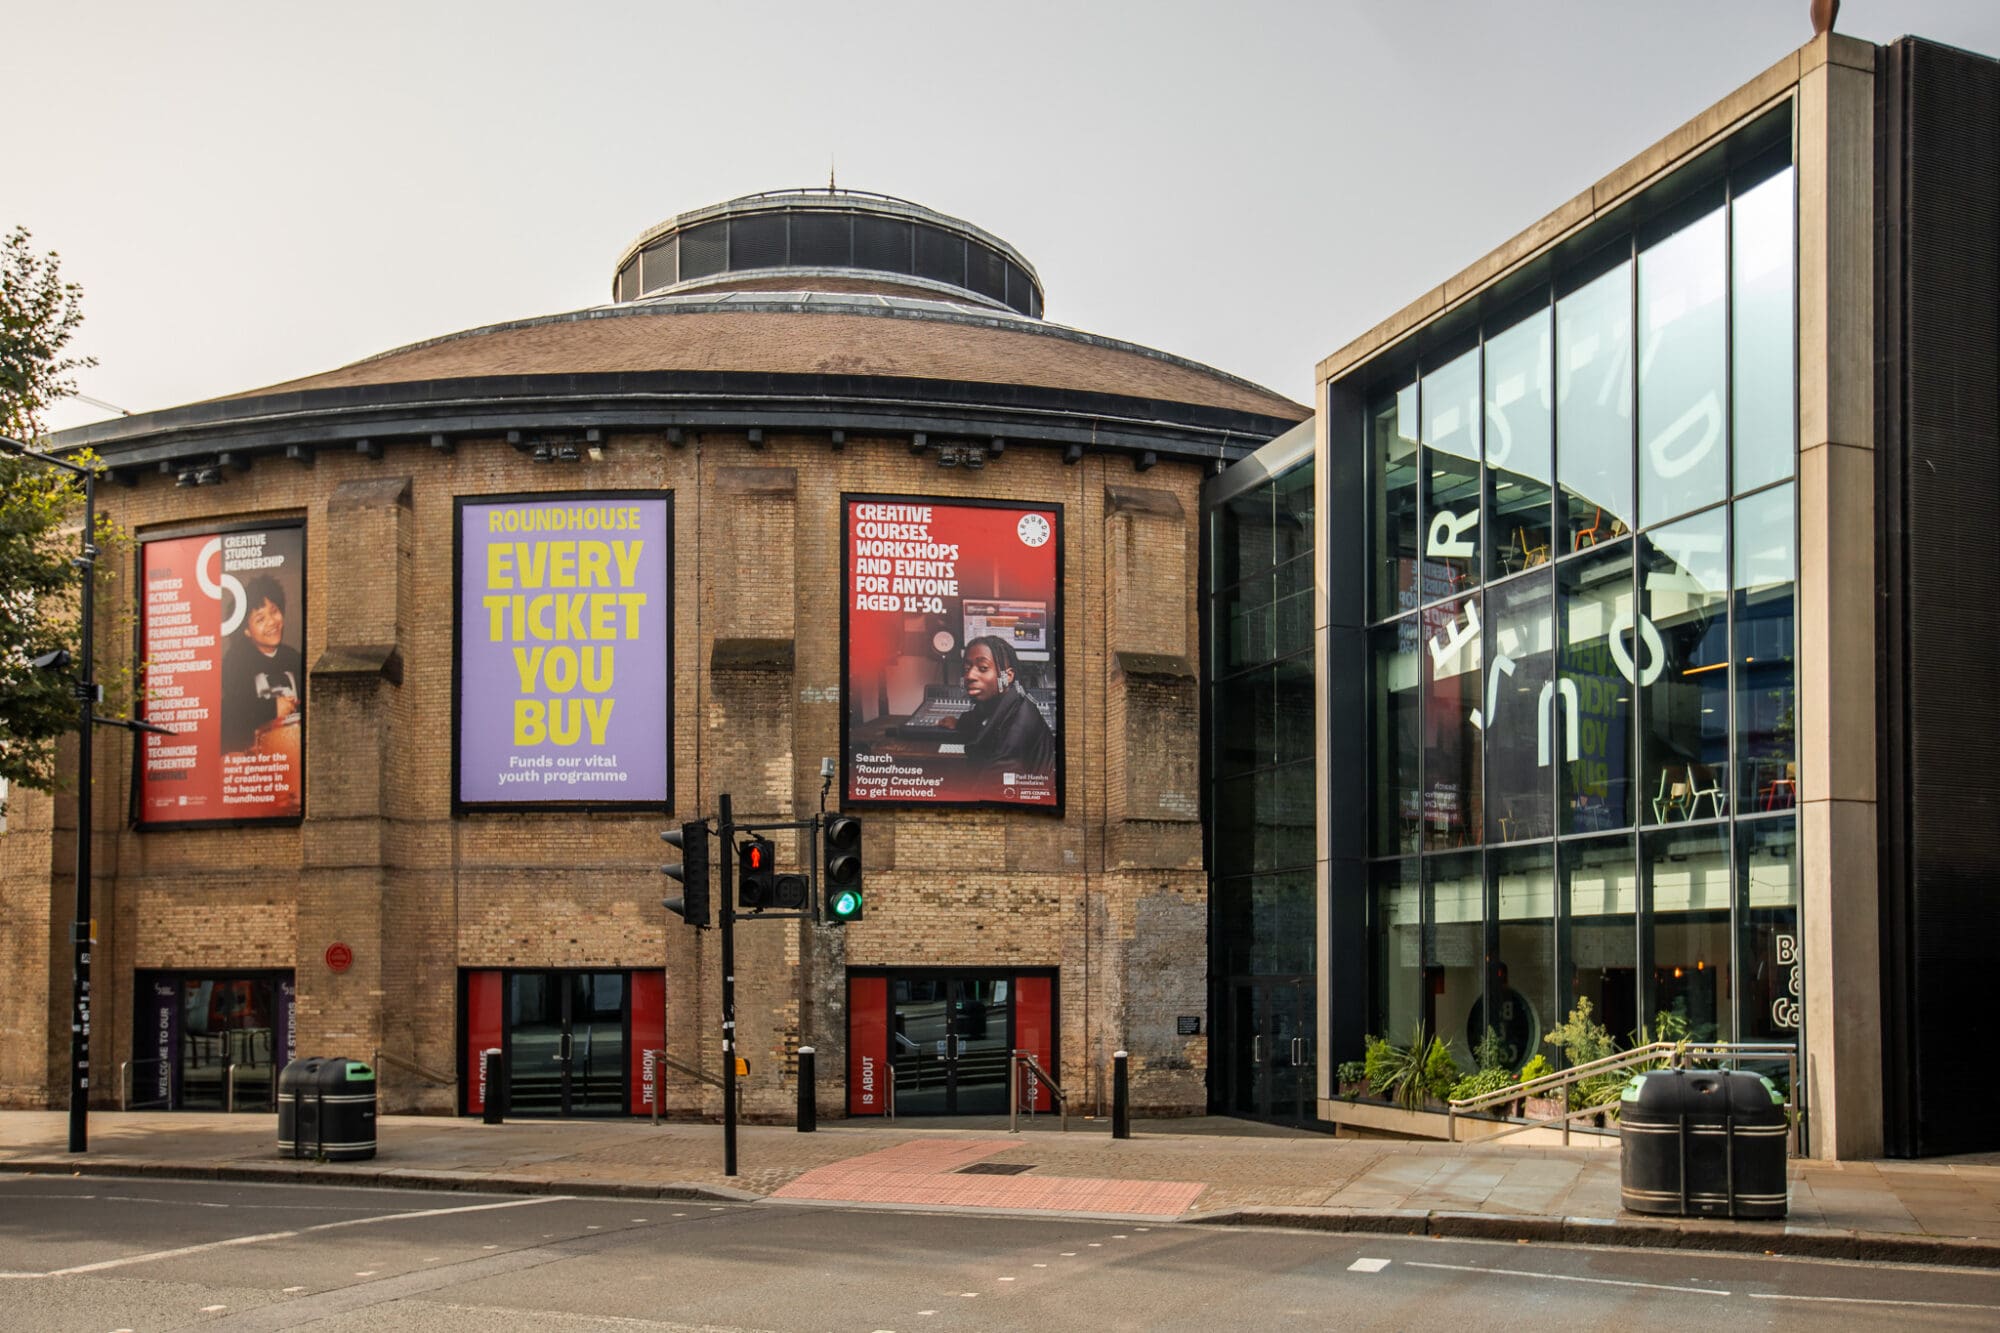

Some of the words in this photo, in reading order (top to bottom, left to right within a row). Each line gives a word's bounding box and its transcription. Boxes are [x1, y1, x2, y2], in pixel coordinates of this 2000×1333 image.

[488, 507, 640, 532] ROUNDHOUSE
[856, 504, 932, 524] CREATIVE
[856, 522, 934, 543] COURSES,
[1020, 516, 1048, 545] ROUNDHOUSE
[225, 534, 266, 548] CREATIVE
[225, 546, 262, 560] STUDIOS
[856, 540, 959, 560] WORKSHOPS
[225, 556, 284, 571] MEMBERSHIP
[487, 540, 644, 590] EVERY
[856, 558, 892, 575] AND
[895, 560, 955, 578] EVENTS
[148, 578, 182, 590] WRITERS
[856, 576, 889, 592] FOR
[892, 578, 959, 596] ANYONE
[148, 591, 178, 603] ACTORS
[856, 594, 900, 612] AGED
[904, 596, 948, 614] 11-30.
[148, 602, 190, 614] MUSICIANS
[148, 614, 192, 626] DESIGNERS
[482, 593, 647, 642] TICKET
[148, 625, 198, 638] FILMMAKERS
[148, 638, 181, 651] THEATRE
[183, 635, 215, 648] MAKERS
[148, 660, 212, 674] ENTREPRENEURS
[512, 646, 615, 694] YOU
[148, 675, 173, 686] POETS
[148, 697, 200, 710] INFLUENCERS
[148, 710, 175, 722] CIRCUS
[176, 708, 208, 720] ARTISTS
[513, 698, 616, 746] BUY
[148, 745, 197, 758] TECHNICIANS
[224, 756, 230, 764] A
[232, 755, 256, 765] space
[258, 754, 270, 762] for
[272, 752, 287, 761] the
[148, 758, 196, 770] PRESENTERS
[510, 754, 553, 768] Funds
[556, 757, 582, 768] our
[584, 754, 618, 767] vital
[856, 754, 892, 764] Search
[224, 765, 242, 774] next
[244, 763, 290, 774] generation
[856, 764, 923, 775] ‘Roundhouse
[224, 776, 232, 784] of
[233, 774, 272, 784] creatives
[274, 773, 283, 781] in
[498, 770, 540, 786] youth
[544, 771, 628, 784] programme
[856, 776, 888, 787] Young
[224, 786, 238, 794] the
[240, 784, 262, 793] heart
[264, 784, 274, 792] of
[275, 782, 289, 792] the
[856, 788, 867, 796] to
[870, 788, 886, 798] get
[890, 788, 936, 798] involved.
[223, 794, 275, 804] Roundhouse
[160, 1008, 169, 1028] OUR
[288, 1002, 296, 1047] STUDIOS
[160, 1030, 169, 1045] TO
[643, 1048, 654, 1077] SHOW
[159, 1047, 168, 1097] WELCOME
[862, 1056, 874, 1092] ABOUT
[643, 1079, 654, 1104] THE
[862, 1094, 874, 1104] IS
